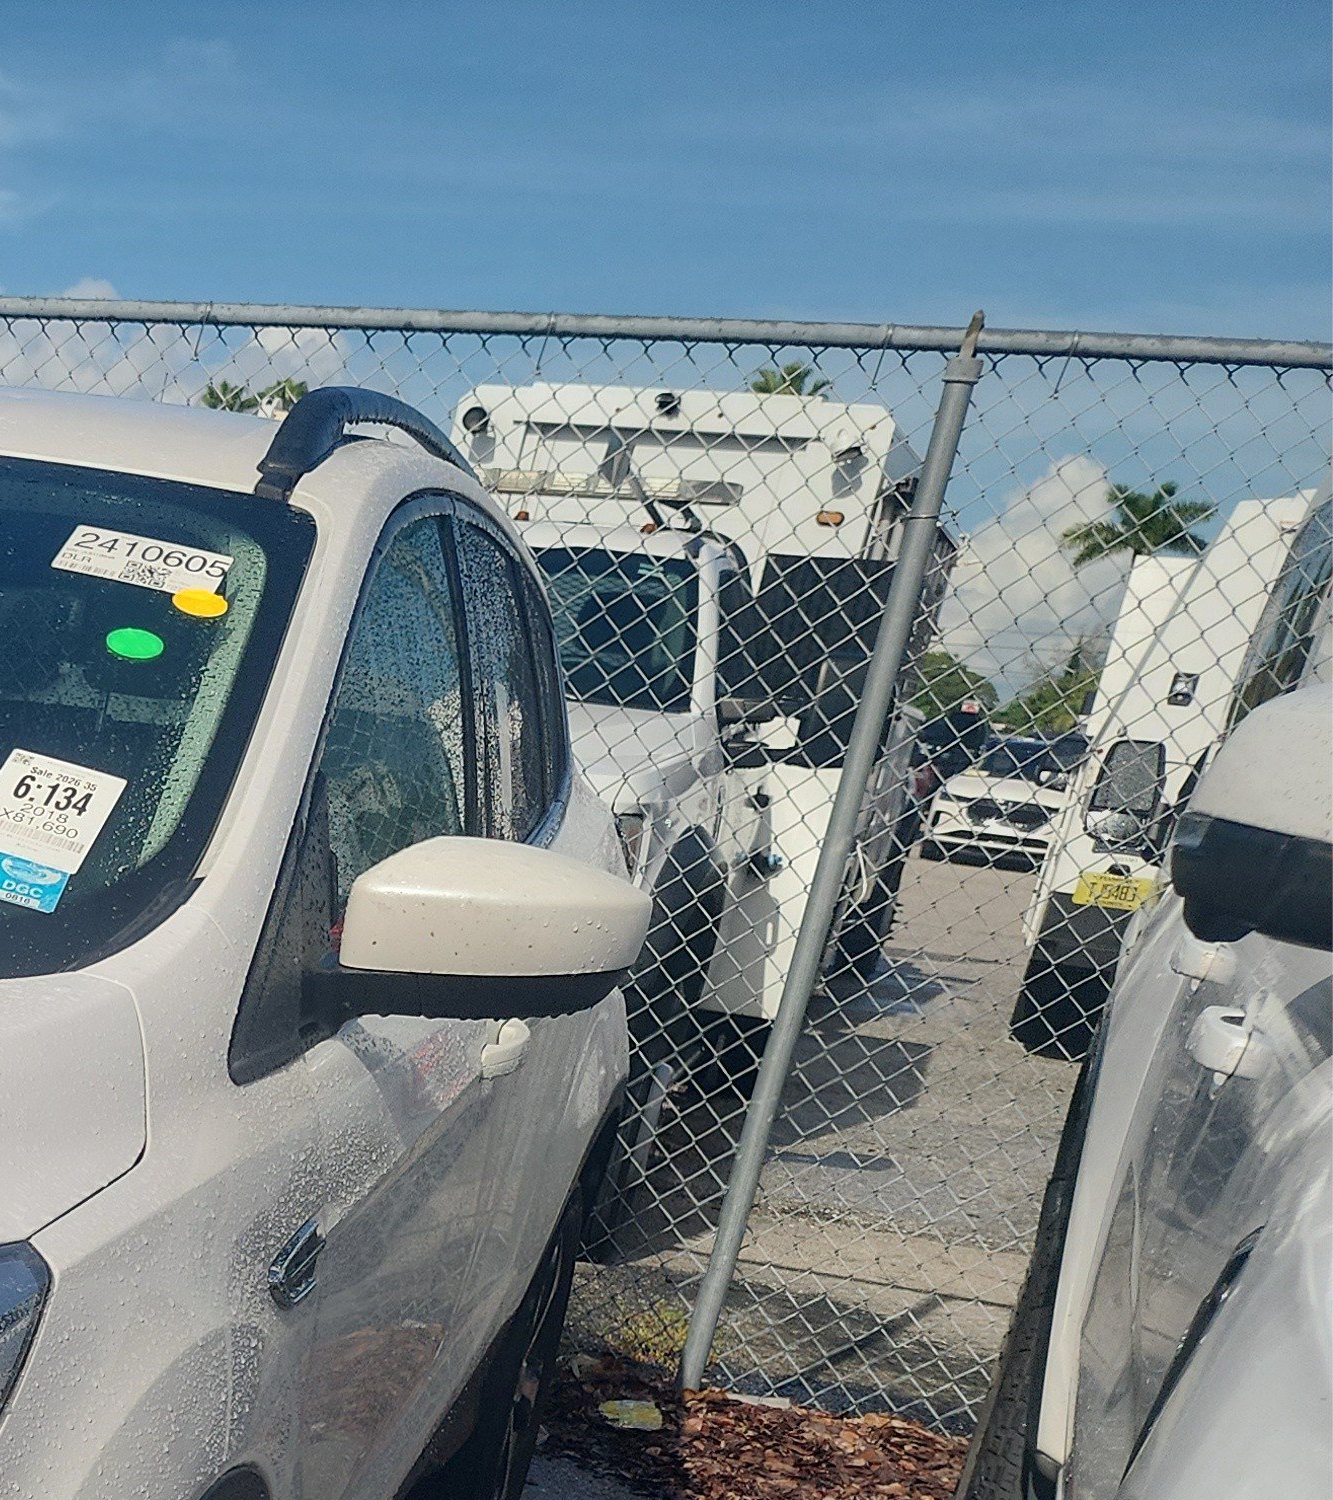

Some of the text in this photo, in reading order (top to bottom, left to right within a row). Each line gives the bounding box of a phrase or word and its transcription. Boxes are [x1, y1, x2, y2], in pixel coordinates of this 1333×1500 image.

[74, 532, 231, 578] 2410605
[30, 766, 53, 779] Sale
[55, 773, 81, 787] 2026
[12, 774, 94, 817] 6:134
[20, 803, 69, 824] 2018
[2, 880, 44, 899] DGC
